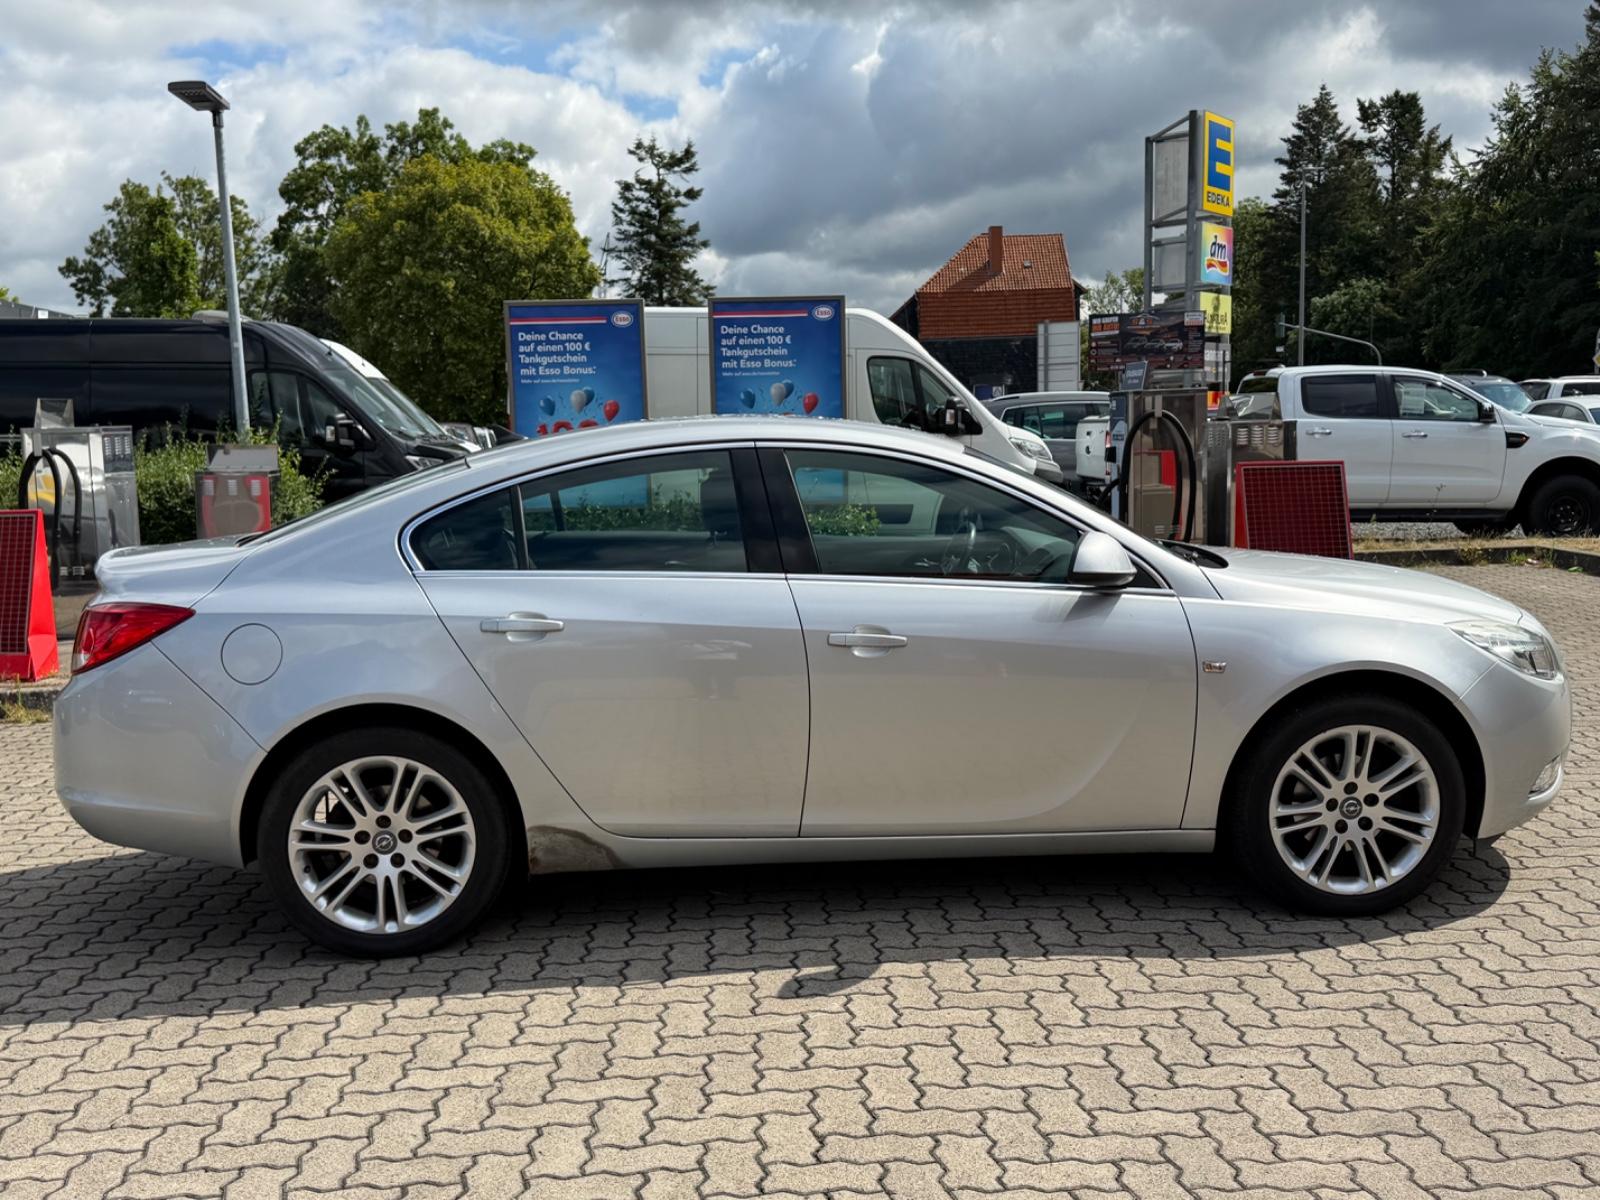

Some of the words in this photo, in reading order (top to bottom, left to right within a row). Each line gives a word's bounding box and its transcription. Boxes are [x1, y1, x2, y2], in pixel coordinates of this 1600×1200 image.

[1207, 120, 1232, 191] E
[1206, 191, 1230, 208] EDEKA
[1210, 234, 1226, 260] dm
[720, 325, 748, 334] Deine
[751, 324, 784, 334] Chance
[518, 332, 546, 341] Deine
[548, 331, 583, 341] Chance
[721, 336, 737, 345] auf
[738, 335, 764, 345] einen
[766, 335, 783, 344] 100
[785, 335, 792, 344] €
[518, 342, 534, 353] auf
[537, 342, 563, 352] einen
[564, 342, 582, 351] 100
[584, 342, 591, 351] €
[720, 346, 788, 358] Tankgutschein
[518, 353, 587, 365] Tankgutschein
[722, 359, 738, 368] mit
[740, 359, 761, 368] Esso
[520, 366, 536, 376] mit
[538, 366, 561, 375] Esso
